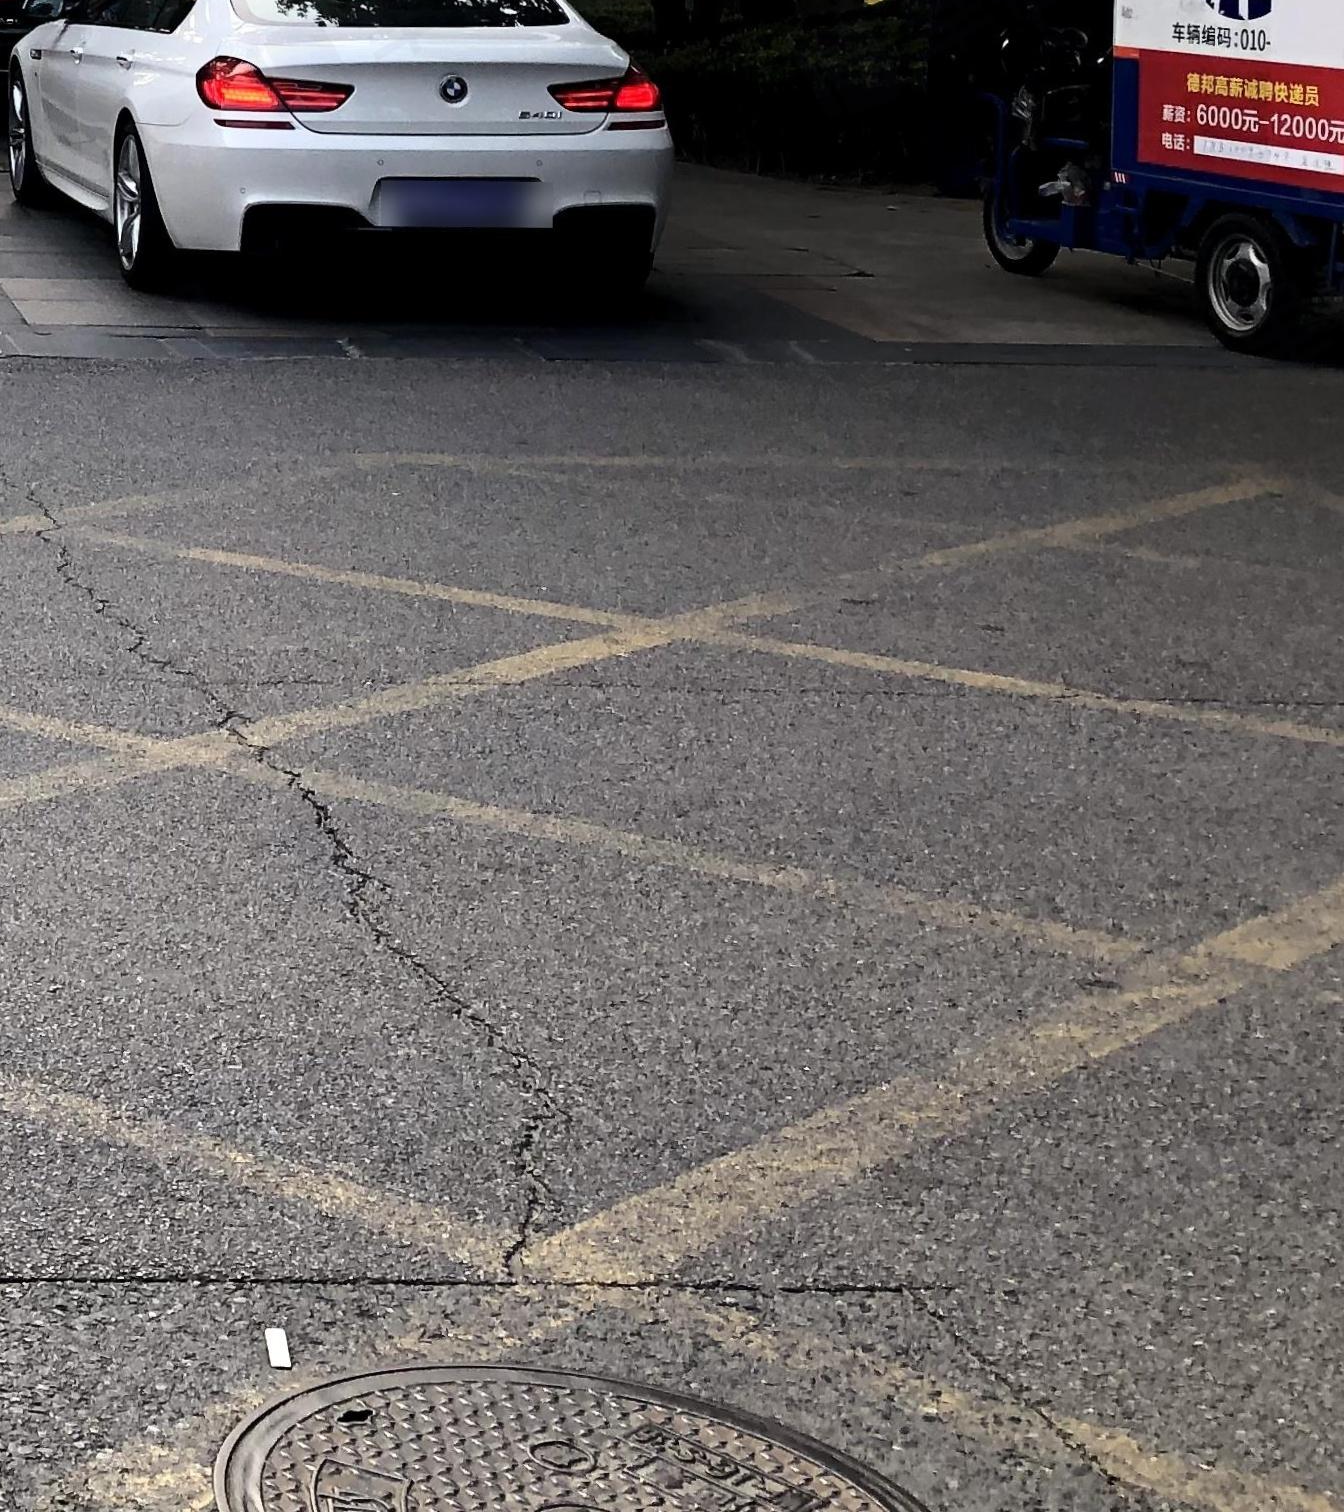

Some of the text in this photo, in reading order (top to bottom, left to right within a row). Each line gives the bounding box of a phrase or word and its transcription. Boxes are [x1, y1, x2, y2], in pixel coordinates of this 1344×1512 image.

[1186, 72, 1320, 107] 德邦高薪诚聘快递员
